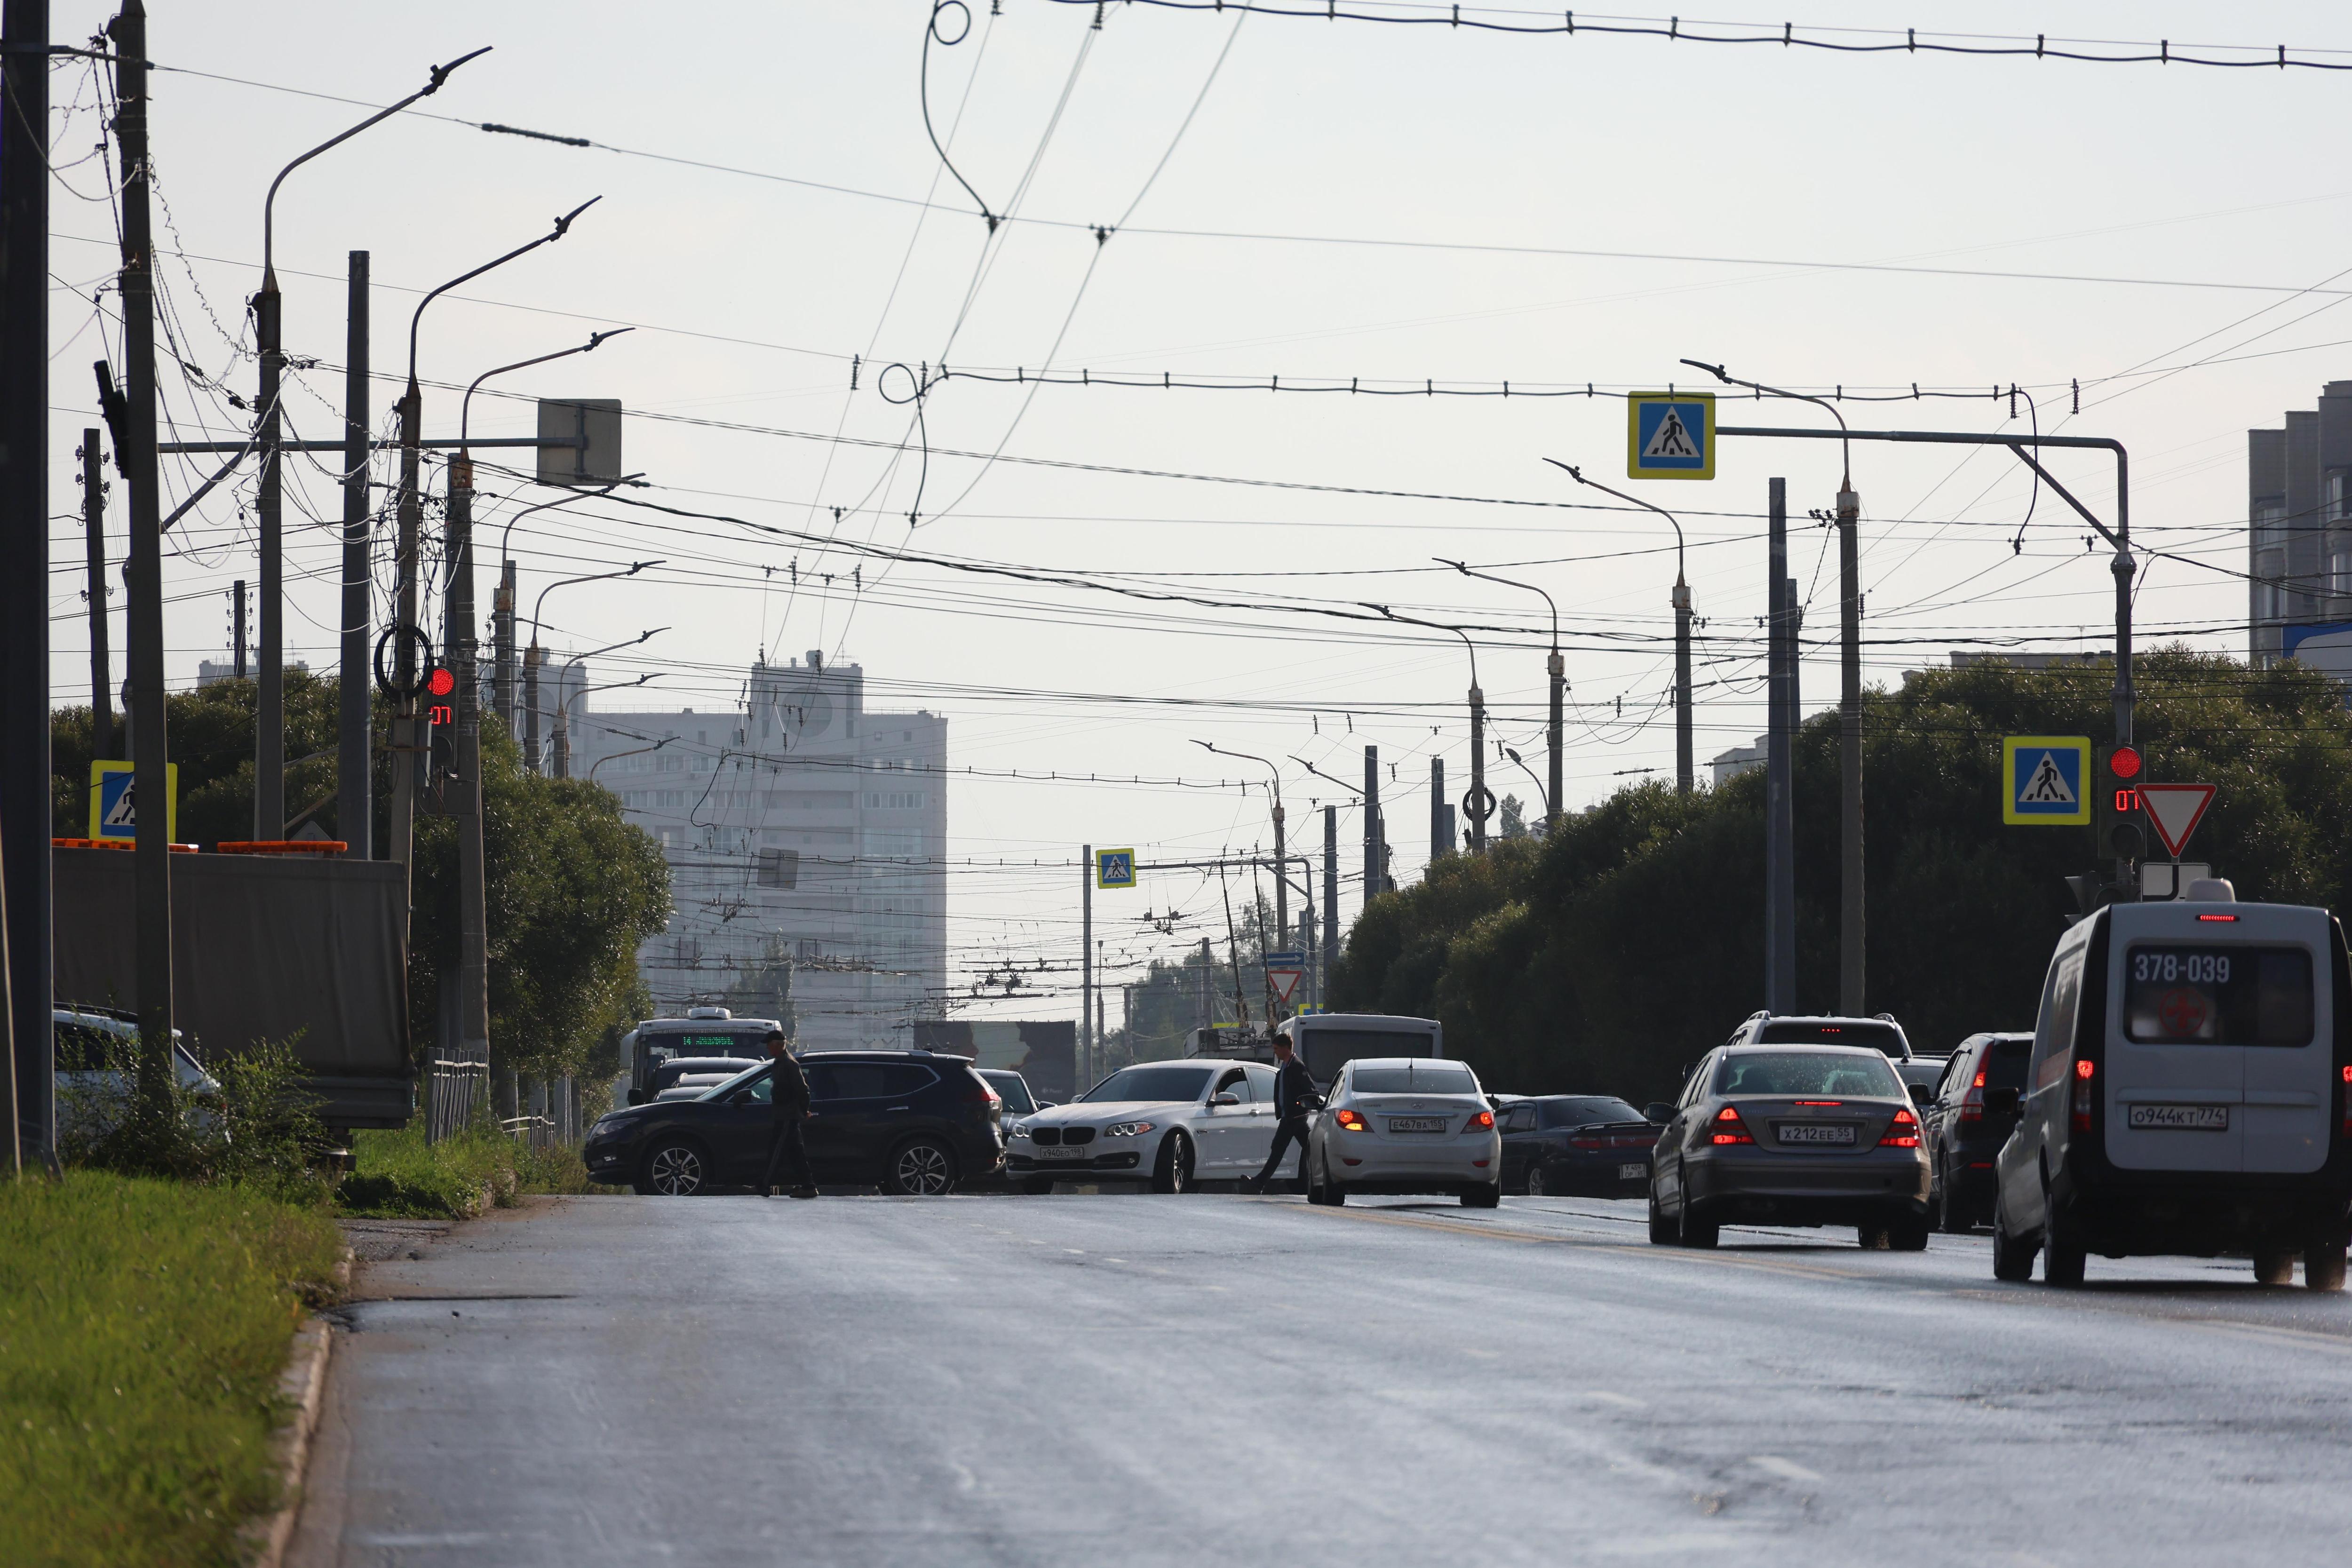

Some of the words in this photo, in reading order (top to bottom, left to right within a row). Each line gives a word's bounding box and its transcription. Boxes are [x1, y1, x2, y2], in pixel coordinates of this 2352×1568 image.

[2116, 790, 2138, 810] 07
[2135, 954, 2230, 983] 378-039
[2135, 1108, 2195, 1123] О944КТ
[2199, 1108, 2225, 1120] 774
[1393, 1120, 1428, 1129] Е467ВА
[1785, 1127, 1834, 1140] Х212ЕЕ
[1837, 1128, 1850, 1137] 55
